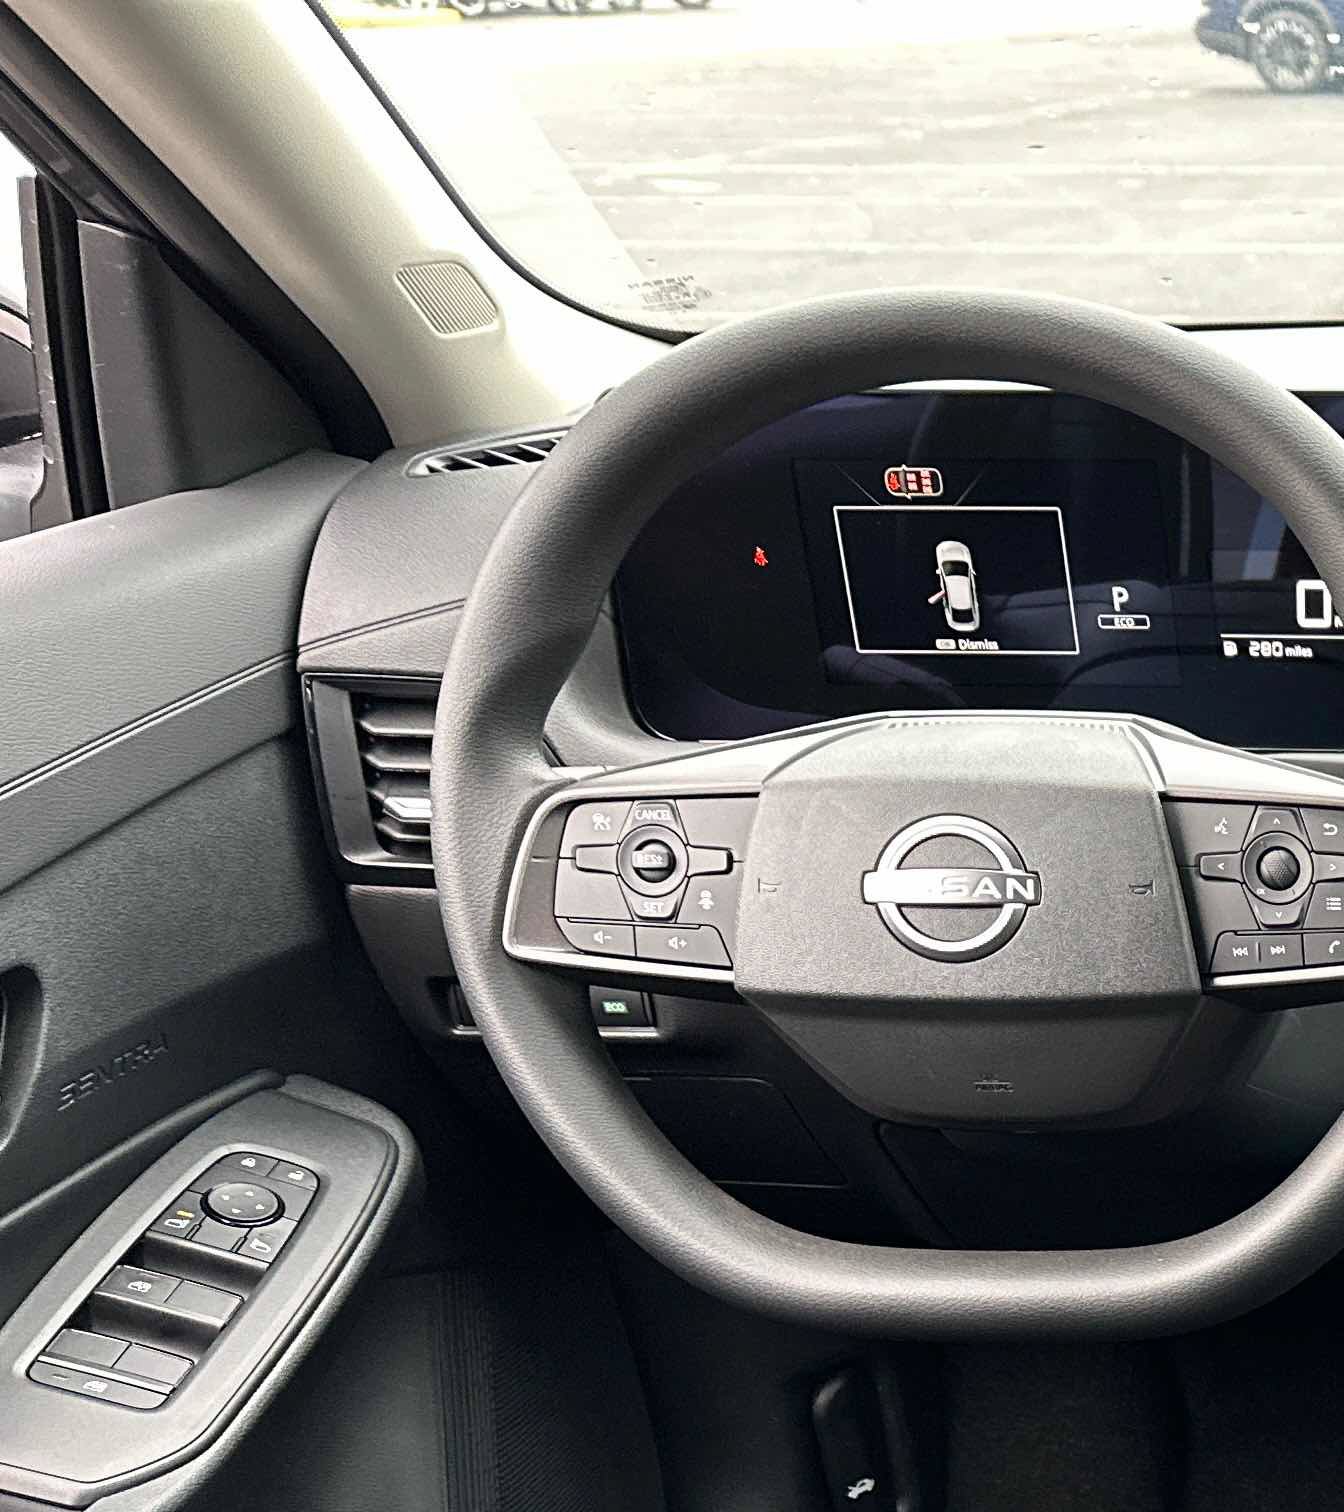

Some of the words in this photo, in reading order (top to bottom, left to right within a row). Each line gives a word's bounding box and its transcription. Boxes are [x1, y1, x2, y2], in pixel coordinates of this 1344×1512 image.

[1111, 585, 1129, 612] P
[1296, 579, 1333, 629] 0
[1113, 617, 1135, 628] ECO
[958, 638, 999, 650] Dismiss
[1248, 640, 1283, 658] 280
[1284, 645, 1313, 658] miles
[634, 809, 672, 822] CANCEL
[641, 903, 664, 914] SET
